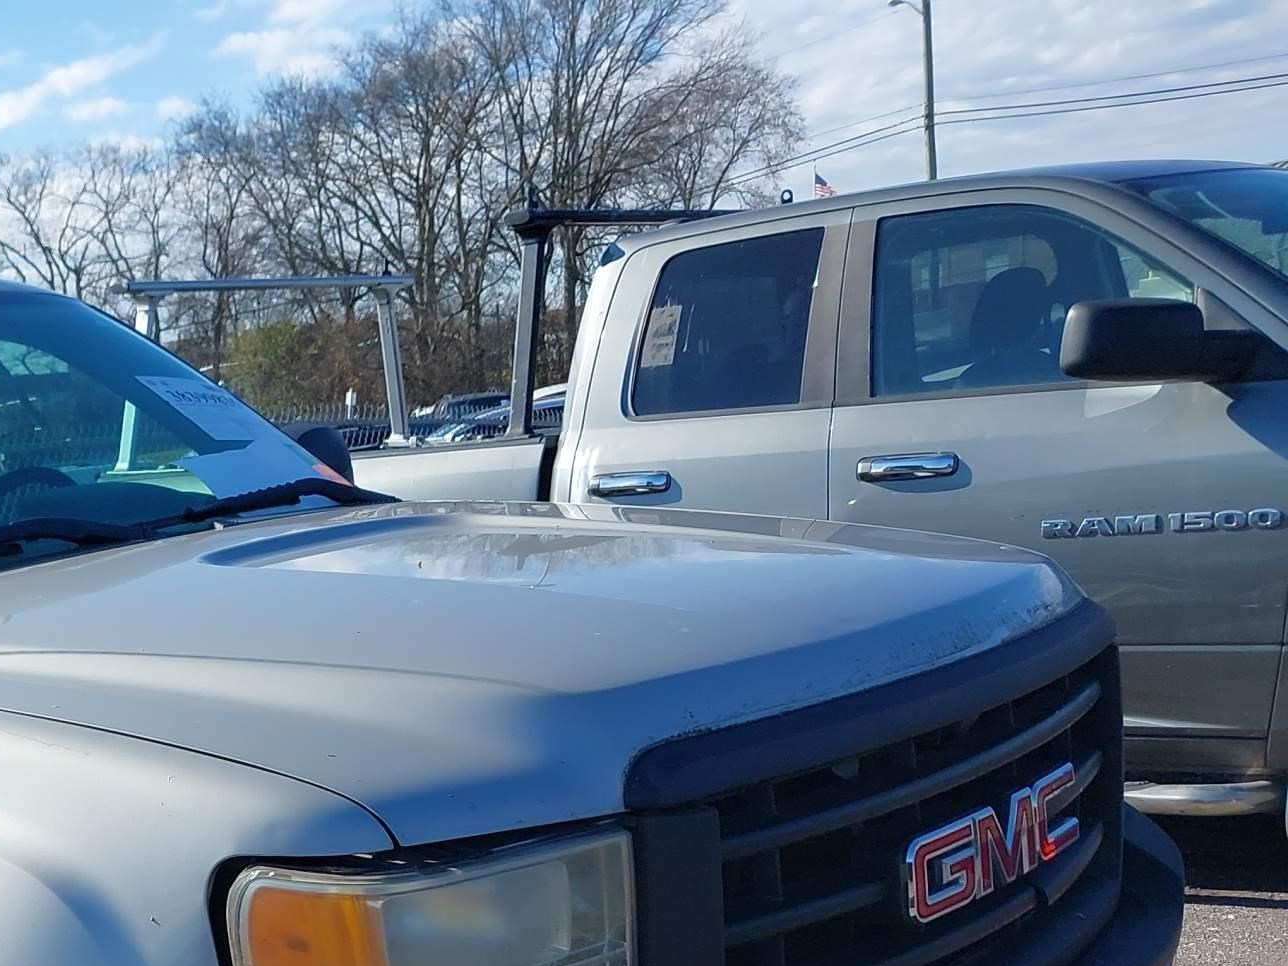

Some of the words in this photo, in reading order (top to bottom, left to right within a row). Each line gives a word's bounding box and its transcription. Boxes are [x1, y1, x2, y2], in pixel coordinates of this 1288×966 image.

[1040, 513, 1160, 538] RAM
[1168, 507, 1284, 532] 1500
[905, 762, 1081, 923] GMC
